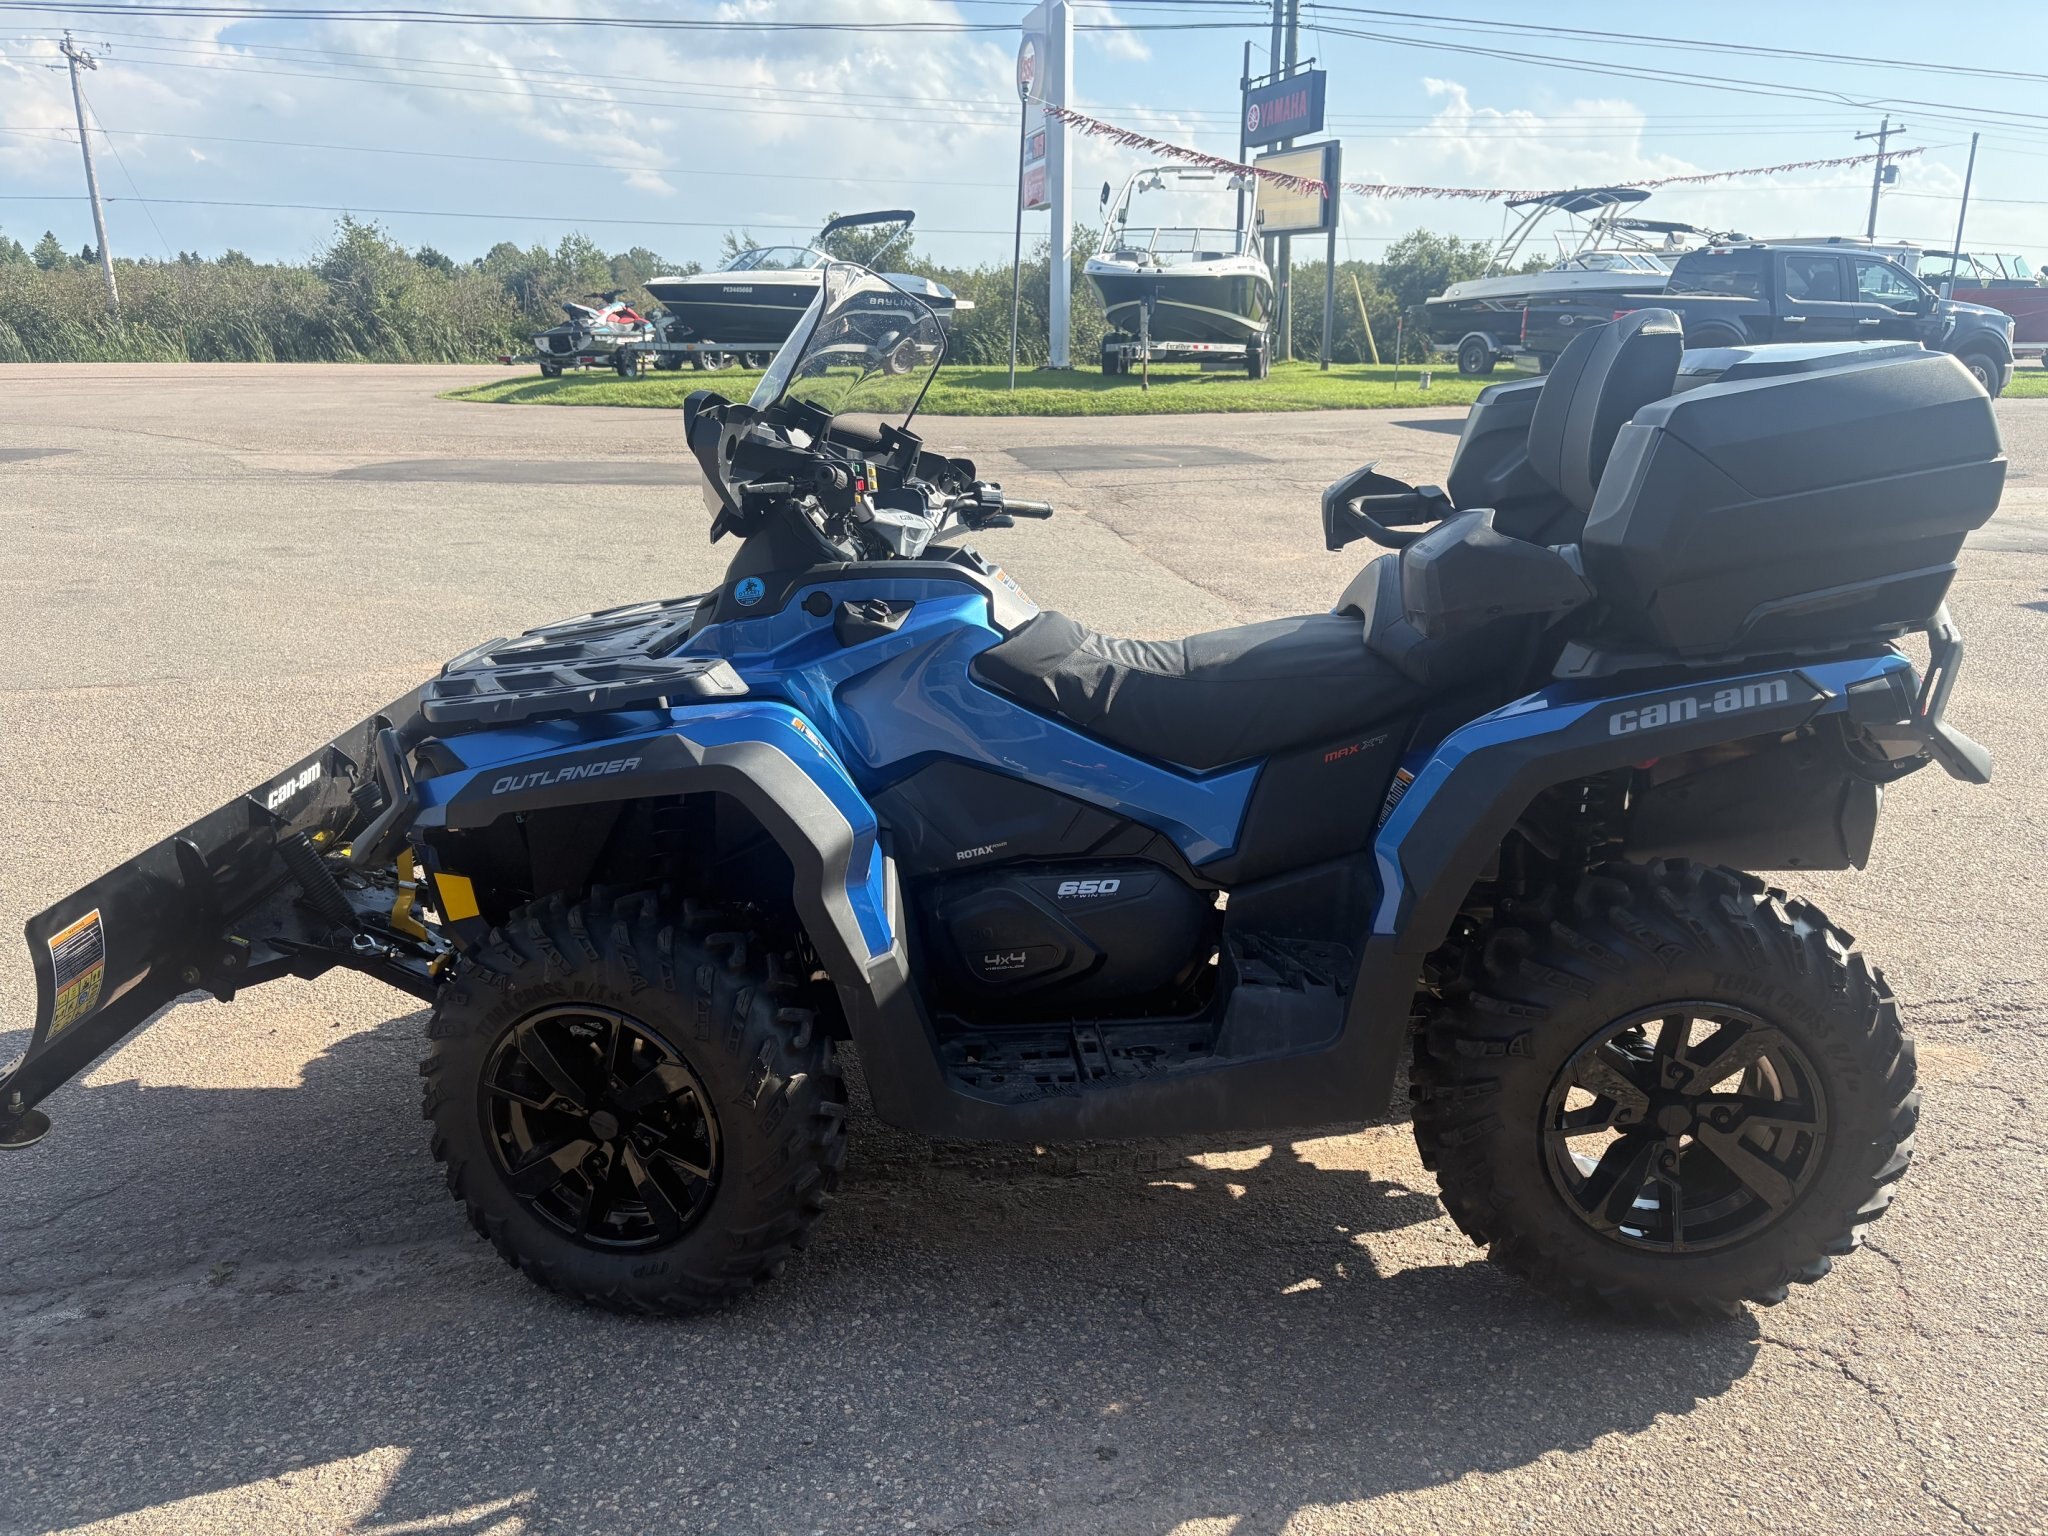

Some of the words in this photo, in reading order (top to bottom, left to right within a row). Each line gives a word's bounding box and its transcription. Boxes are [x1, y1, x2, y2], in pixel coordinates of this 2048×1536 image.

[1261, 89, 1307, 128] YAMAHA
[869, 297, 926, 307] BAYLIN
[1609, 679, 1788, 736] can-am
[1324, 743, 1360, 765] MAX
[268, 760, 321, 810] can-am
[491, 756, 642, 795] OUTLANDER
[956, 844, 994, 861] ROTAX
[1057, 879, 1121, 896] 650
[984, 951, 1027, 966] 4x4
